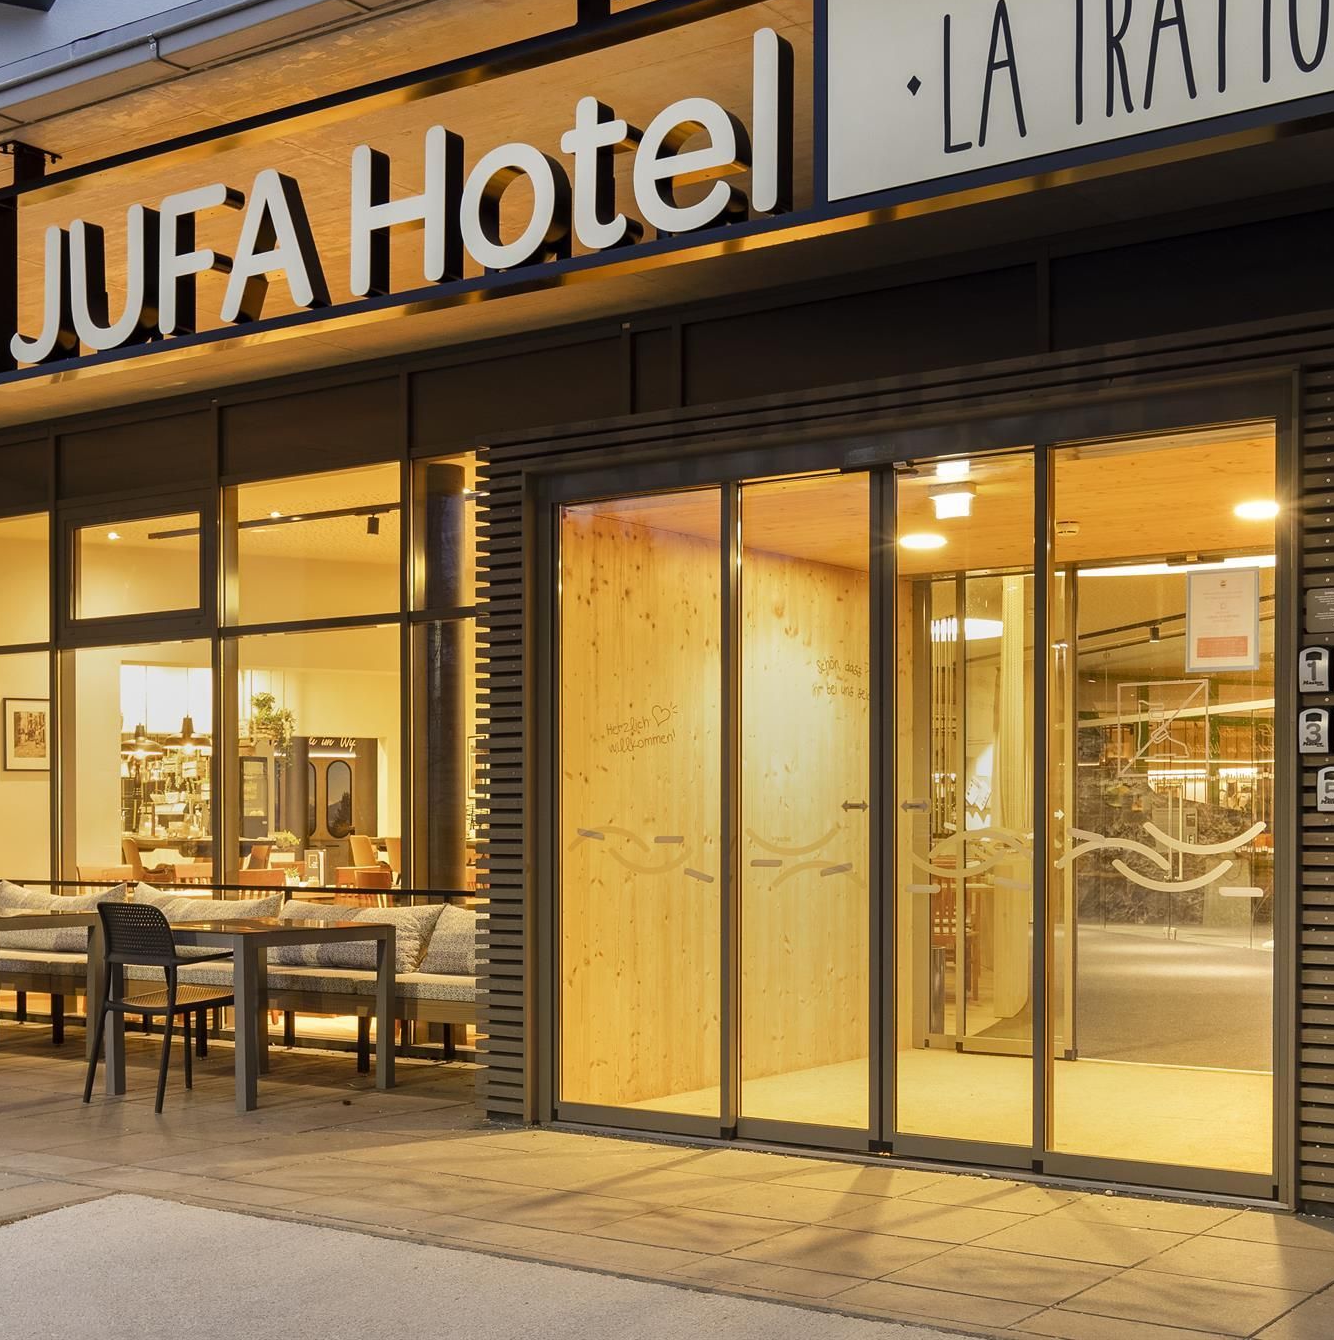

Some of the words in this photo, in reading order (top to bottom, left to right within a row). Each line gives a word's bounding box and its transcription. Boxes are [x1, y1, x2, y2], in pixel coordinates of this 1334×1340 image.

[9, 167, 319, 364] JUFA
[350, 26, 783, 297] Hotel
[1307, 660, 1317, 681] 1
[606, 716, 650, 736] Herzlich
[1305, 723, 1322, 743] 3
[608, 728, 676, 754] willkommen!
